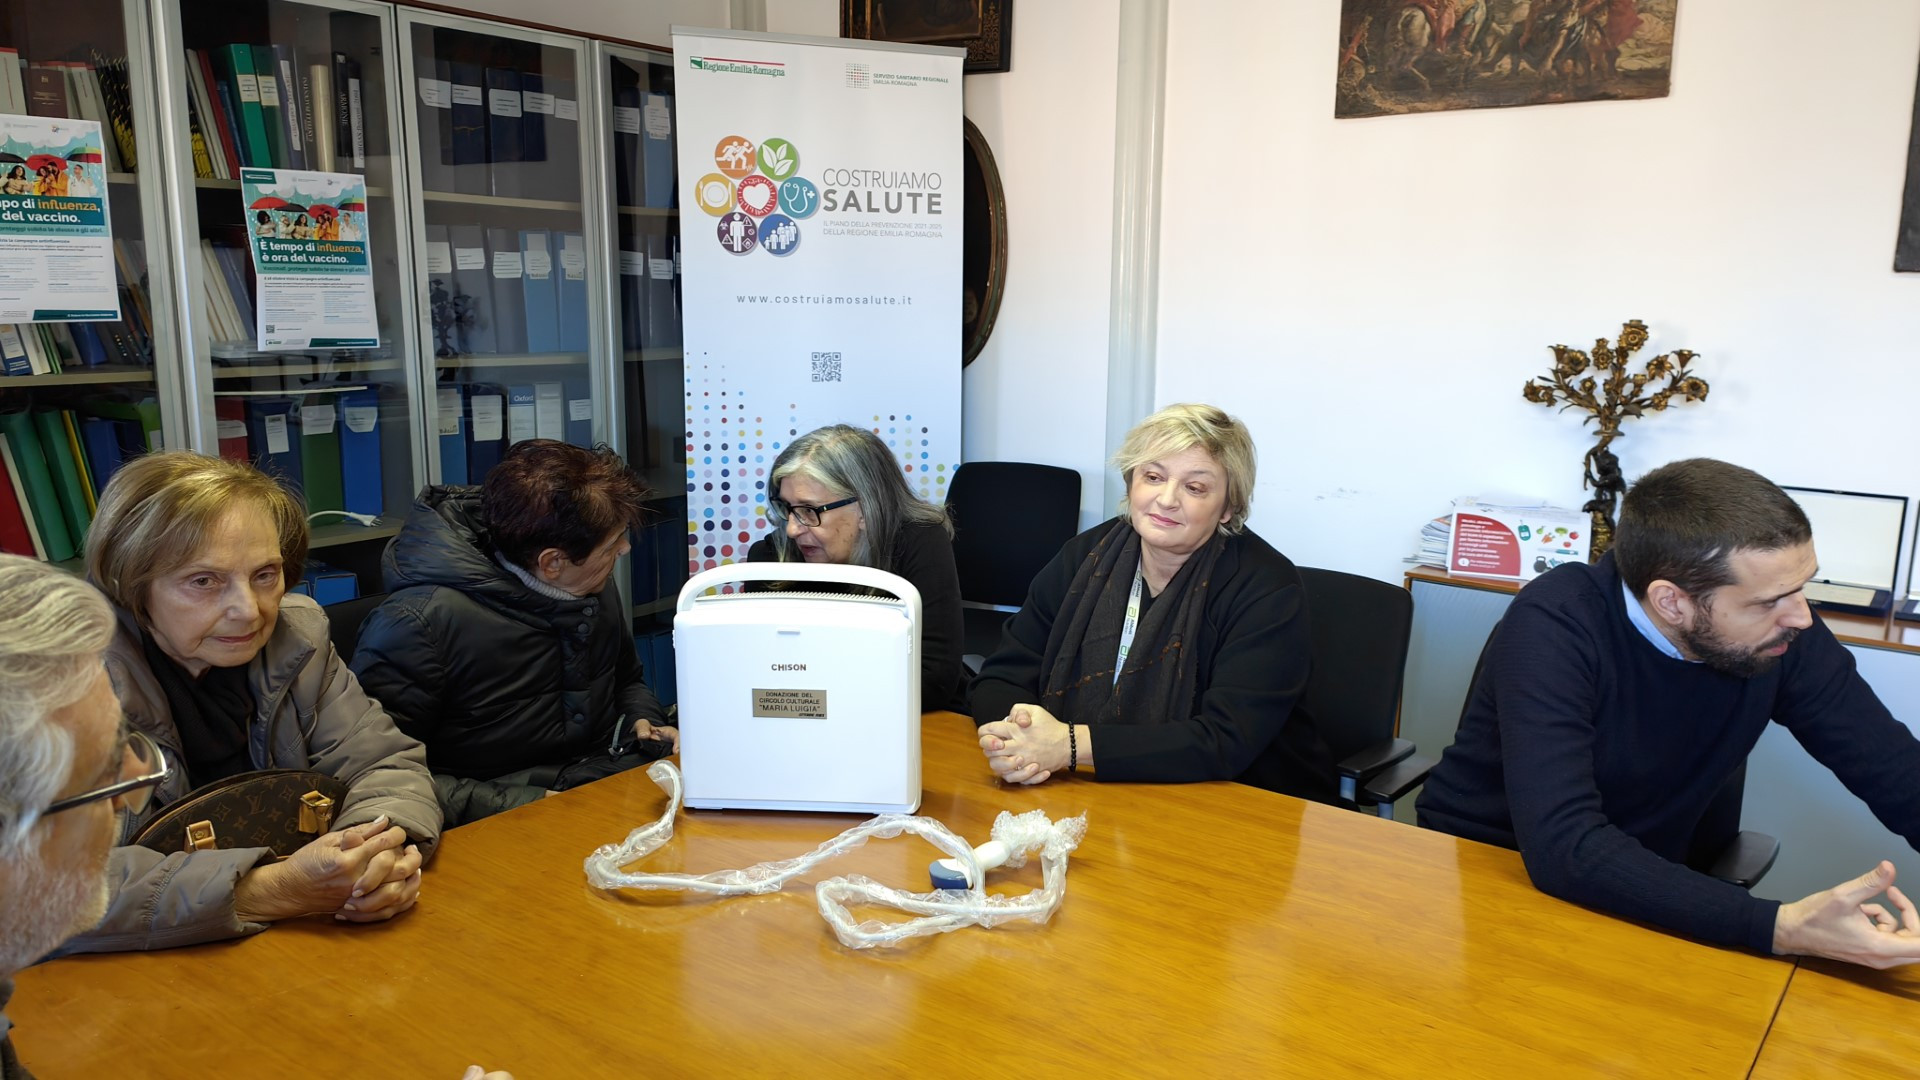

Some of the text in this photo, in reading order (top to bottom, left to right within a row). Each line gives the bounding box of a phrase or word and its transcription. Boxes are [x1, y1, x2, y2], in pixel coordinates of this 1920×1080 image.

[703, 61, 785, 77] Regione Emilia-Romagna
[823, 168, 942, 190] COSTRUIAMO
[22, 199, 35, 209] di
[38, 199, 101, 213] influenza,
[823, 188, 942, 215] SALUTE
[2, 211, 81, 223] del vaccino.
[823, 228, 943, 239] DELLA REGIONE EMILIA ROMAGNA
[260, 239, 364, 254] È tempo di influenza,
[262, 252, 349, 264] è ora del vaccino.
[736, 294, 912, 305] www.costruiamosalute.it
[514, 394, 534, 402] Oxford
[771, 663, 807, 671] CHISON
[759, 704, 788, 712] "MARIA
